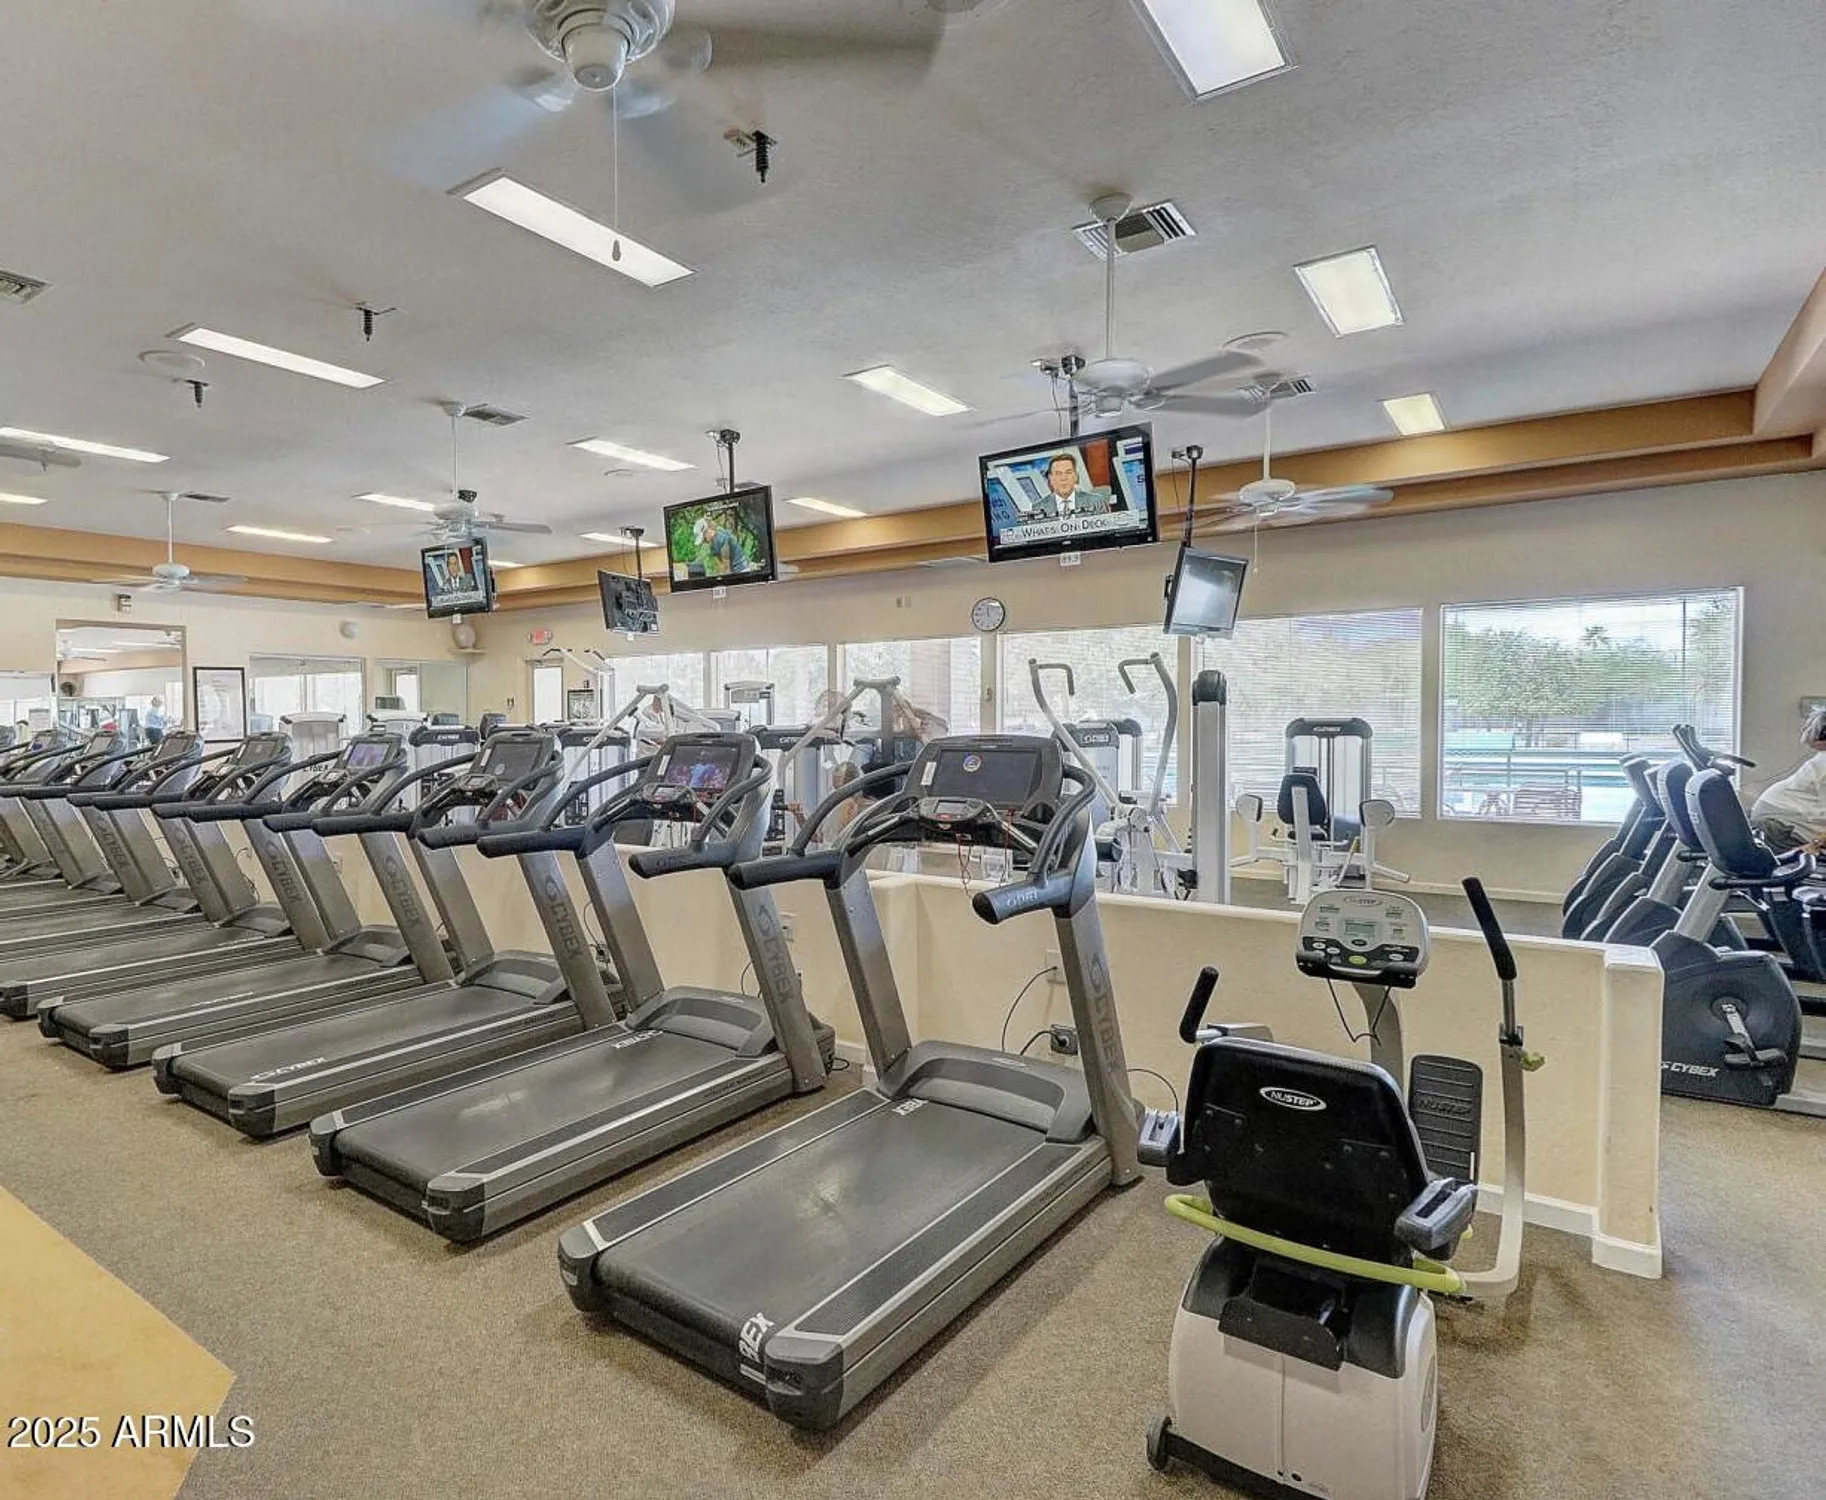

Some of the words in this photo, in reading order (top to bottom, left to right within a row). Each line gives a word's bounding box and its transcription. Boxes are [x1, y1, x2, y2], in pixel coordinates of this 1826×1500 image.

[1060, 522, 1077, 534] ON
[1082, 519, 1107, 530] DECK
[547, 901, 586, 959] CYBEX
[761, 936, 798, 1003] CYBEX
[1670, 1062, 1720, 1077] CYBEX
[1270, 1090, 1315, 1107] NUSTEP
